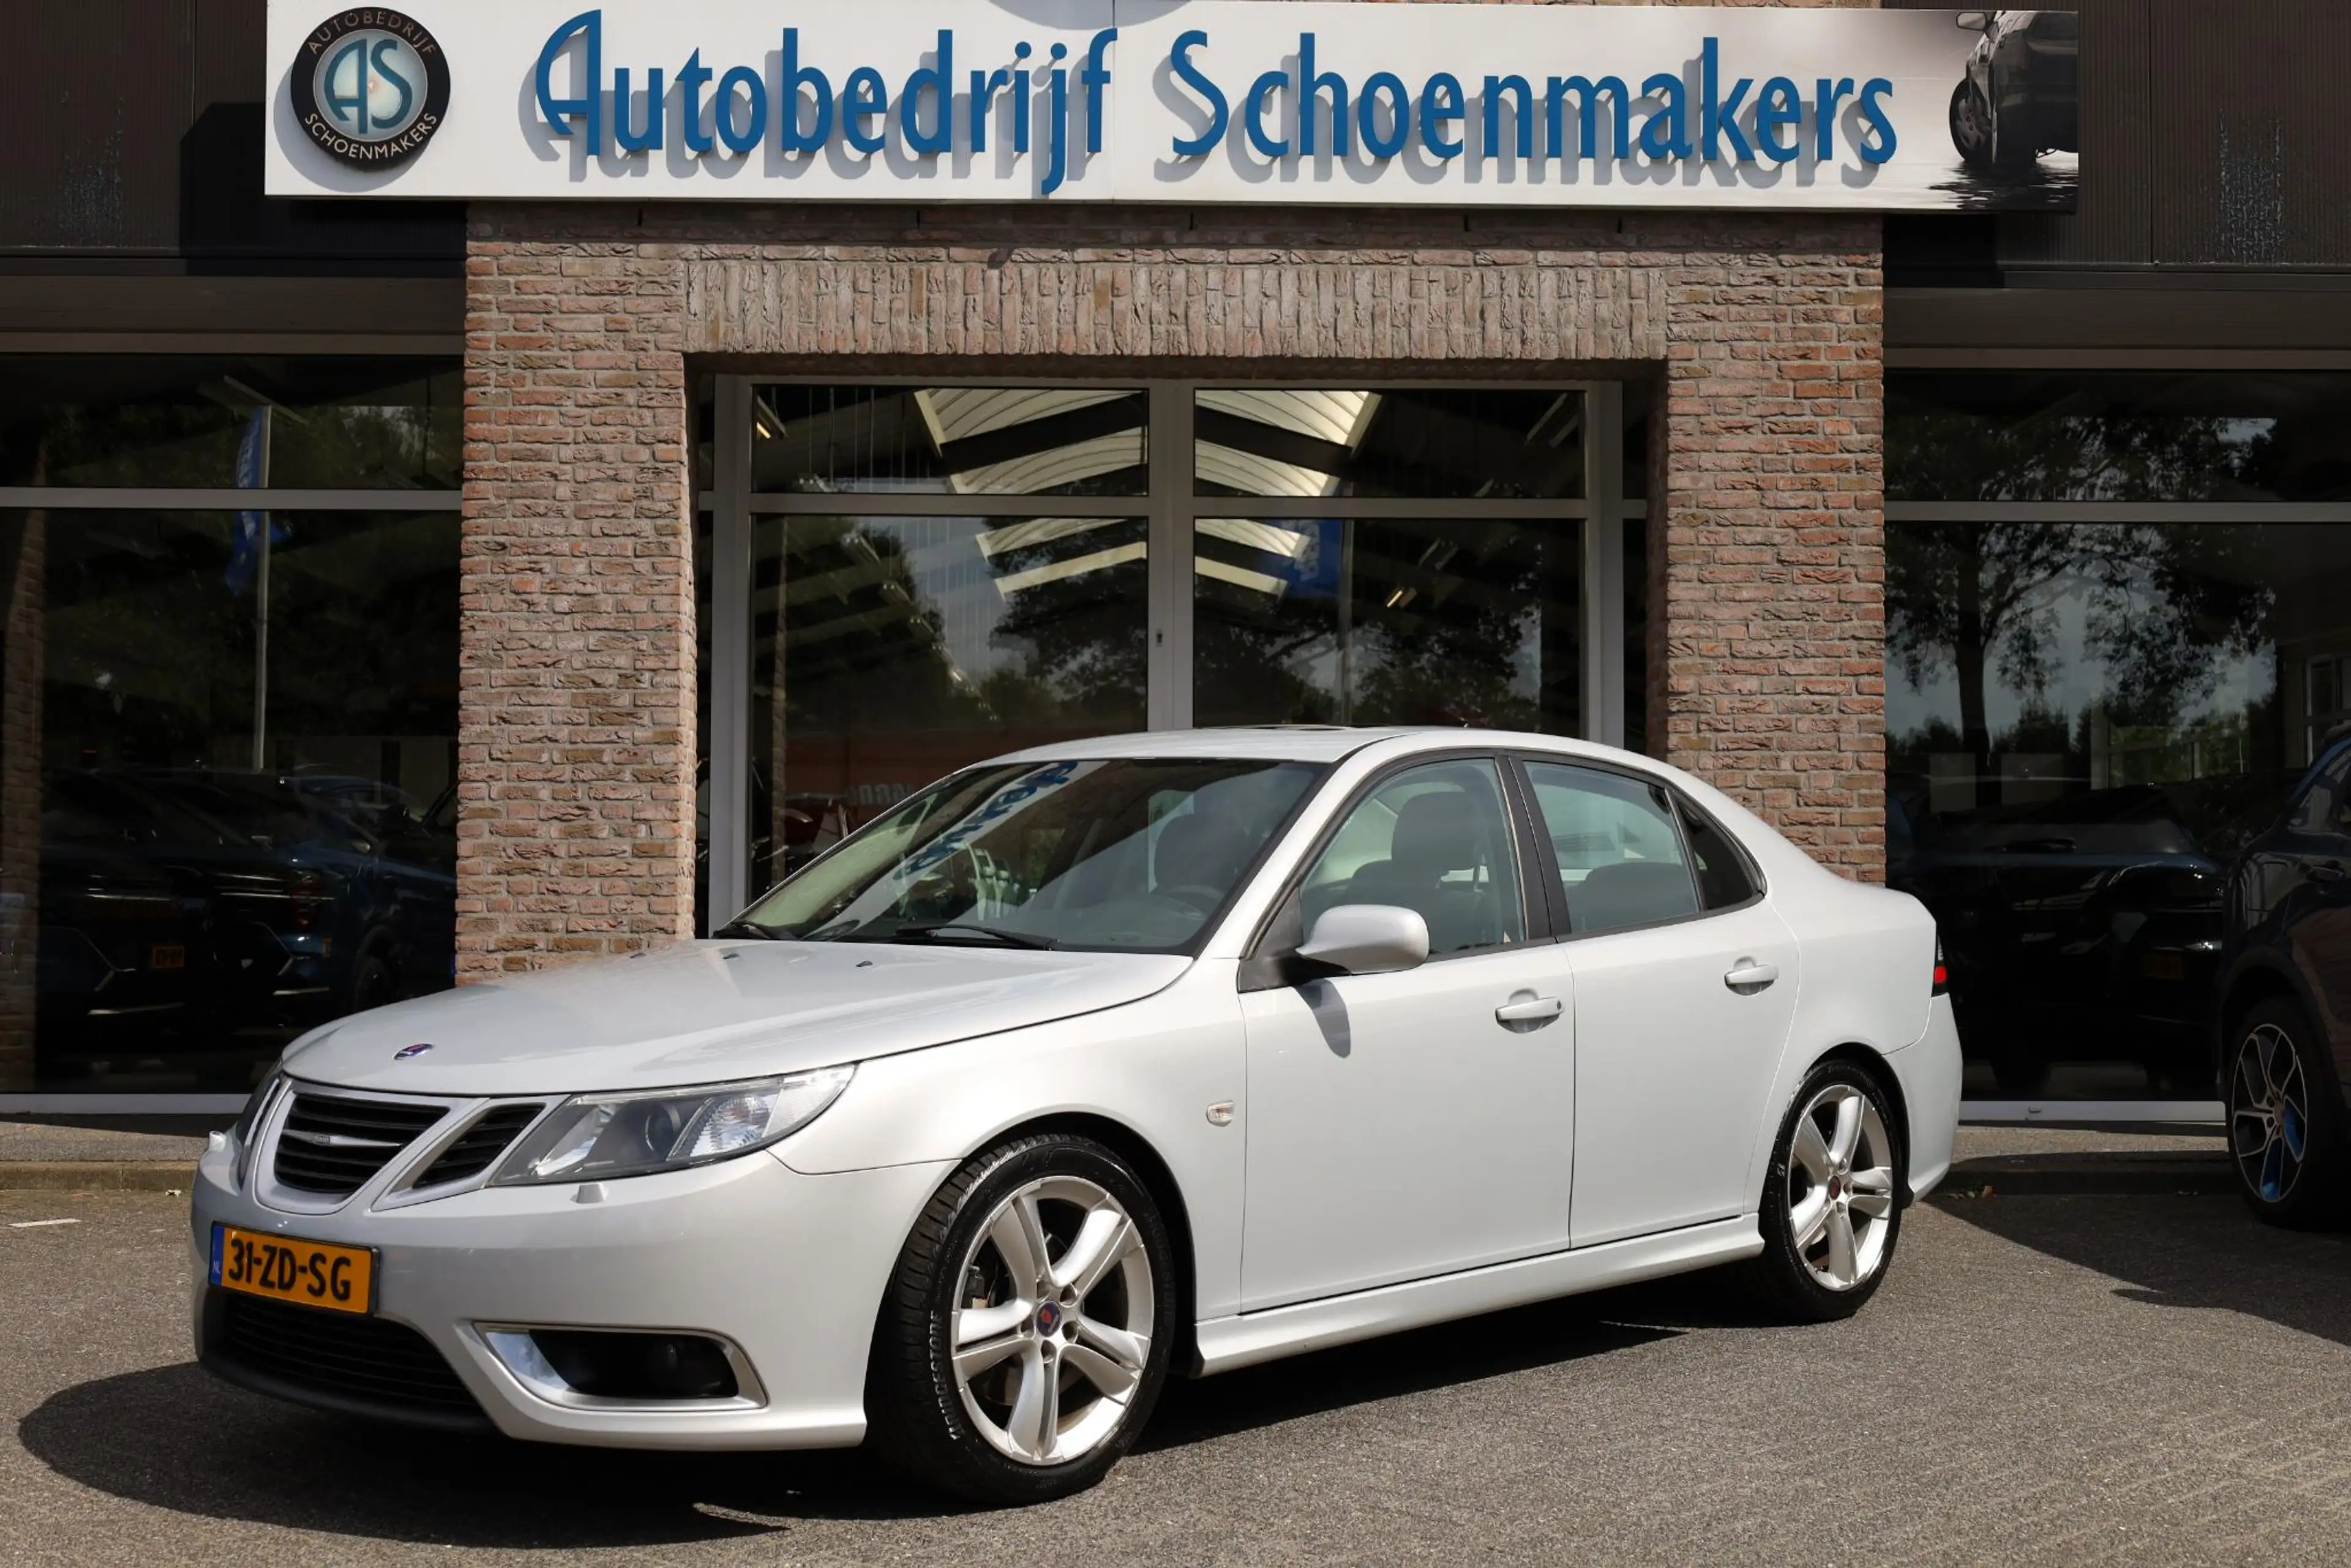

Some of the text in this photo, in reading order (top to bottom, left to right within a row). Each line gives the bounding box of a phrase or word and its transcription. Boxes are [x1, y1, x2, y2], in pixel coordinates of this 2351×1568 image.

[307, 10, 437, 55] AUTOBEDRIJF
[324, 37, 413, 135] AS
[535, 9, 1897, 194] Autobedrijf Schoenmakers
[304, 113, 437, 160] SCHOENMAKERS
[228, 1237, 351, 1302] 31-ZD-SG
